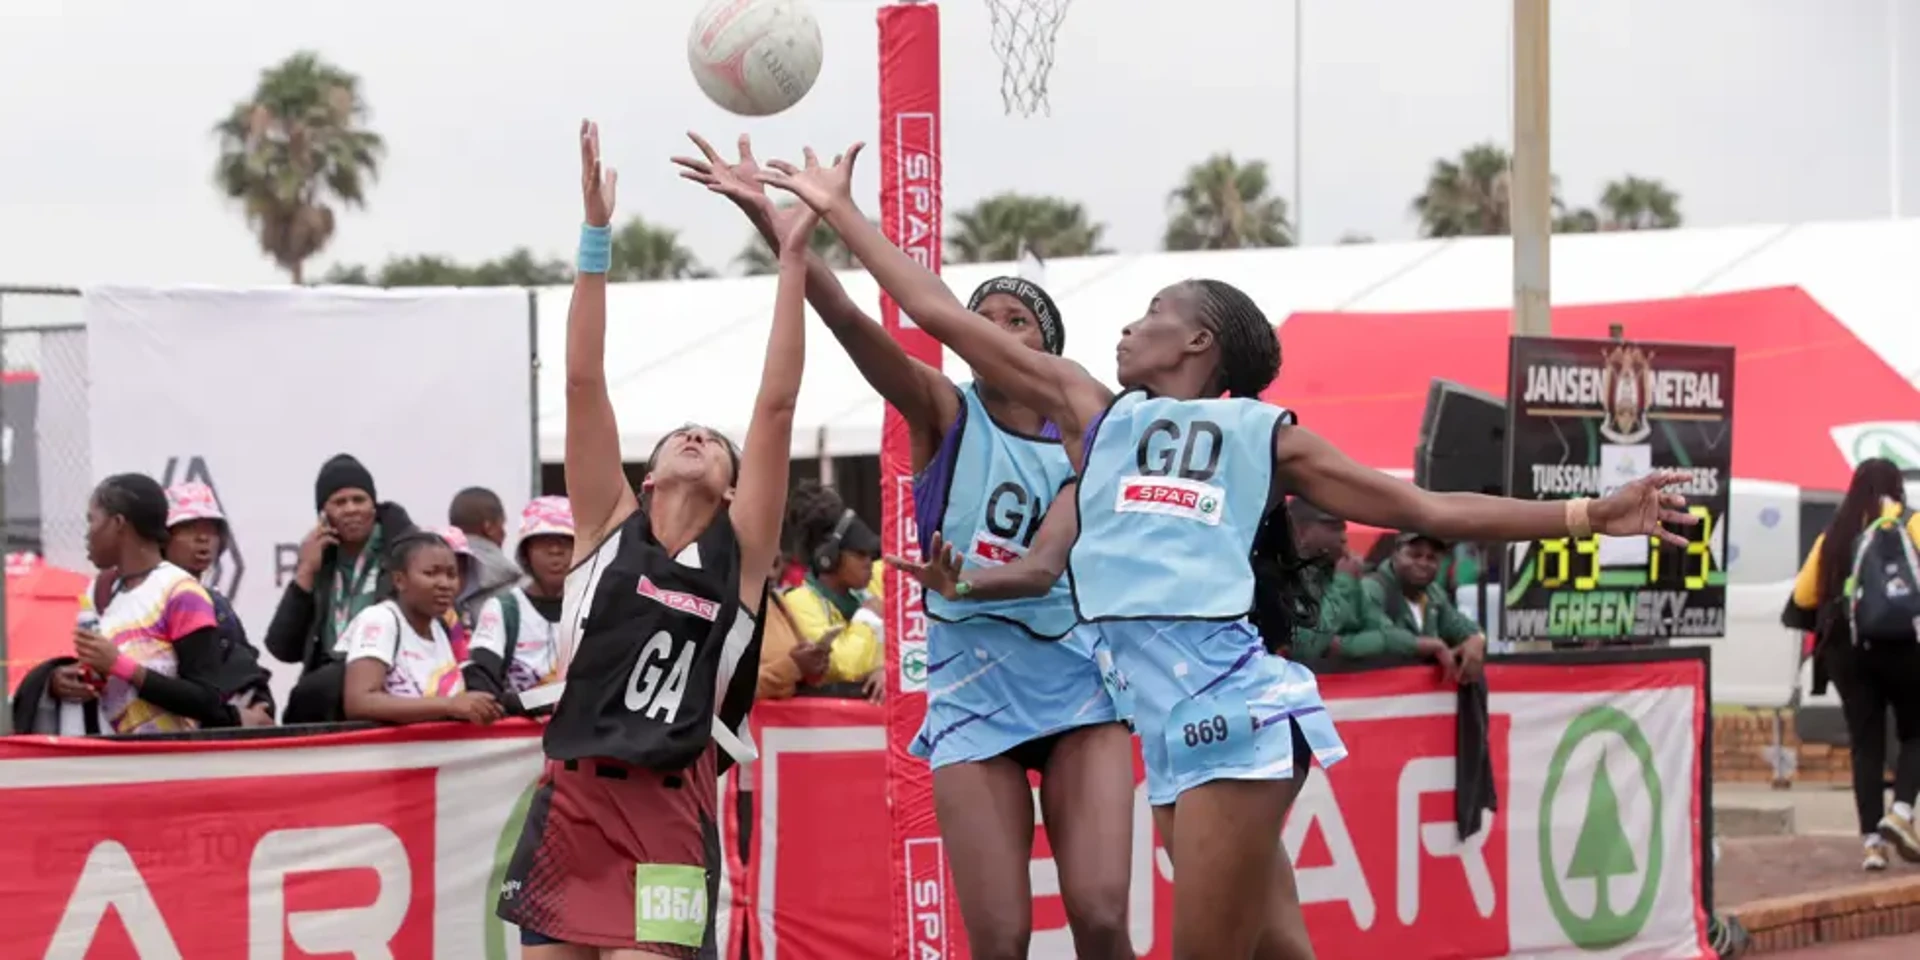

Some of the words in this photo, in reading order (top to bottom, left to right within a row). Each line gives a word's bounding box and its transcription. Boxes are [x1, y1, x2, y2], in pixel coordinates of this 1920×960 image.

[1524, 365, 1606, 402] JANSEN
[1648, 370, 1724, 408] NETBAL
[1136, 418, 1223, 481] GD
[1140, 486, 1196, 506] SPAR
[624, 630, 696, 724] GA
[1183, 715, 1229, 748] 869
[640, 886, 706, 924] 1354
